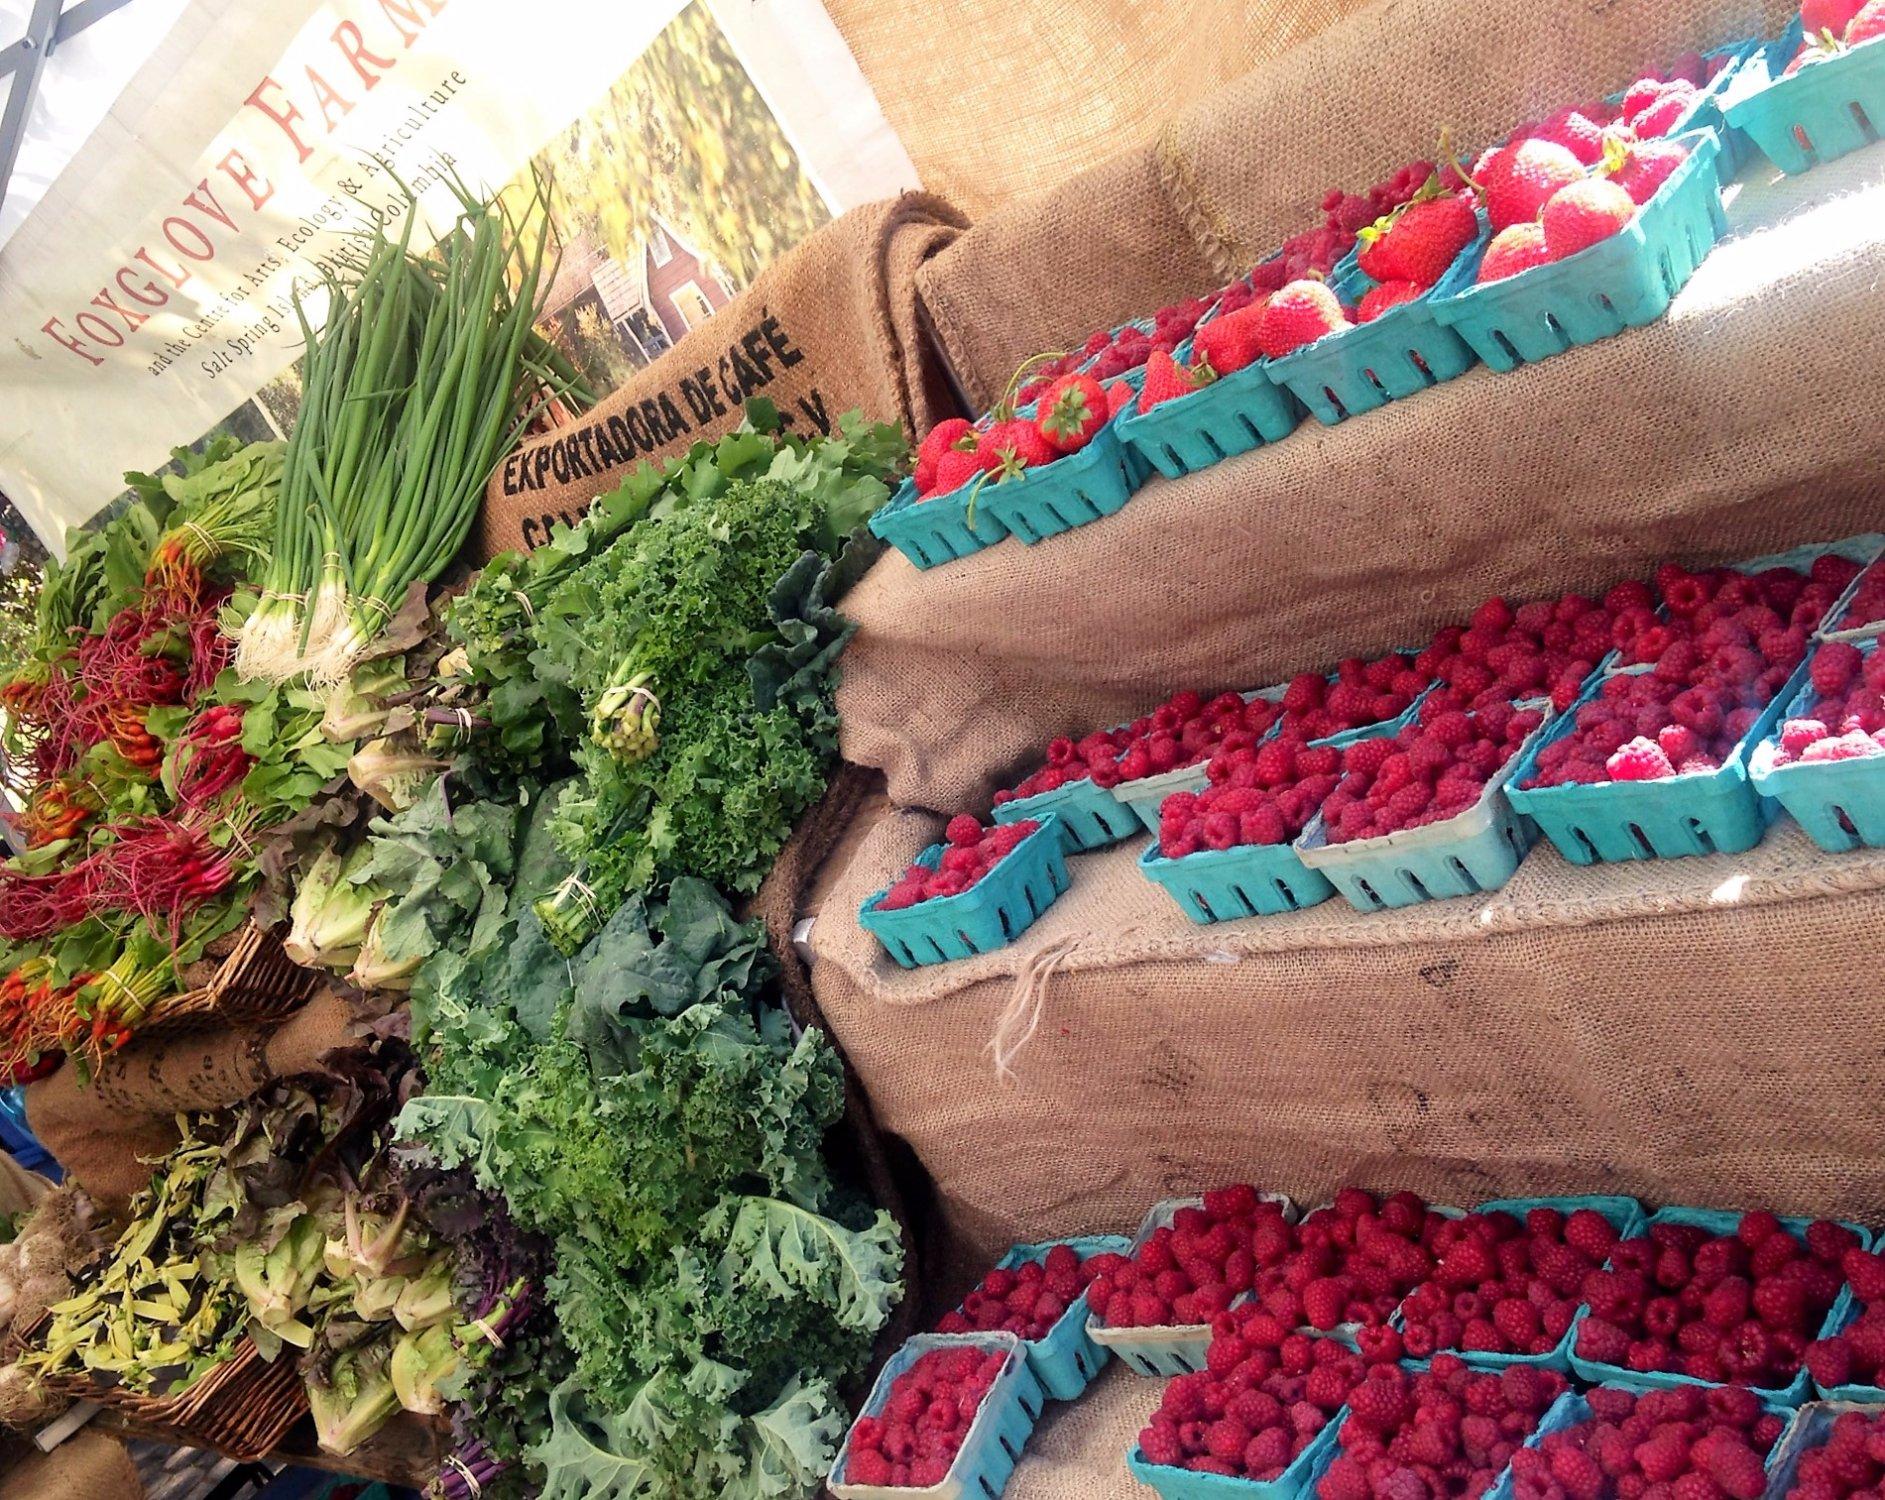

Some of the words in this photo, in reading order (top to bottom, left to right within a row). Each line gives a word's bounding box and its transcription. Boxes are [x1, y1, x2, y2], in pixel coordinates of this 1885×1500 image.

[41, 148, 275, 366] FOXGLOVE
[148, 352, 173, 377] and
[165, 338, 191, 357] the
[182, 304, 230, 339] Centre
[219, 286, 250, 306] for
[276, 195, 348, 252] Ecology
[338, 178, 363, 195] &
[357, 71, 466, 178] Agriculture
[201, 351, 233, 379] Salt
[226, 316, 280, 355] Spring
[503, 390, 691, 497] EXPORTADORA
[679, 366, 728, 426] DE
